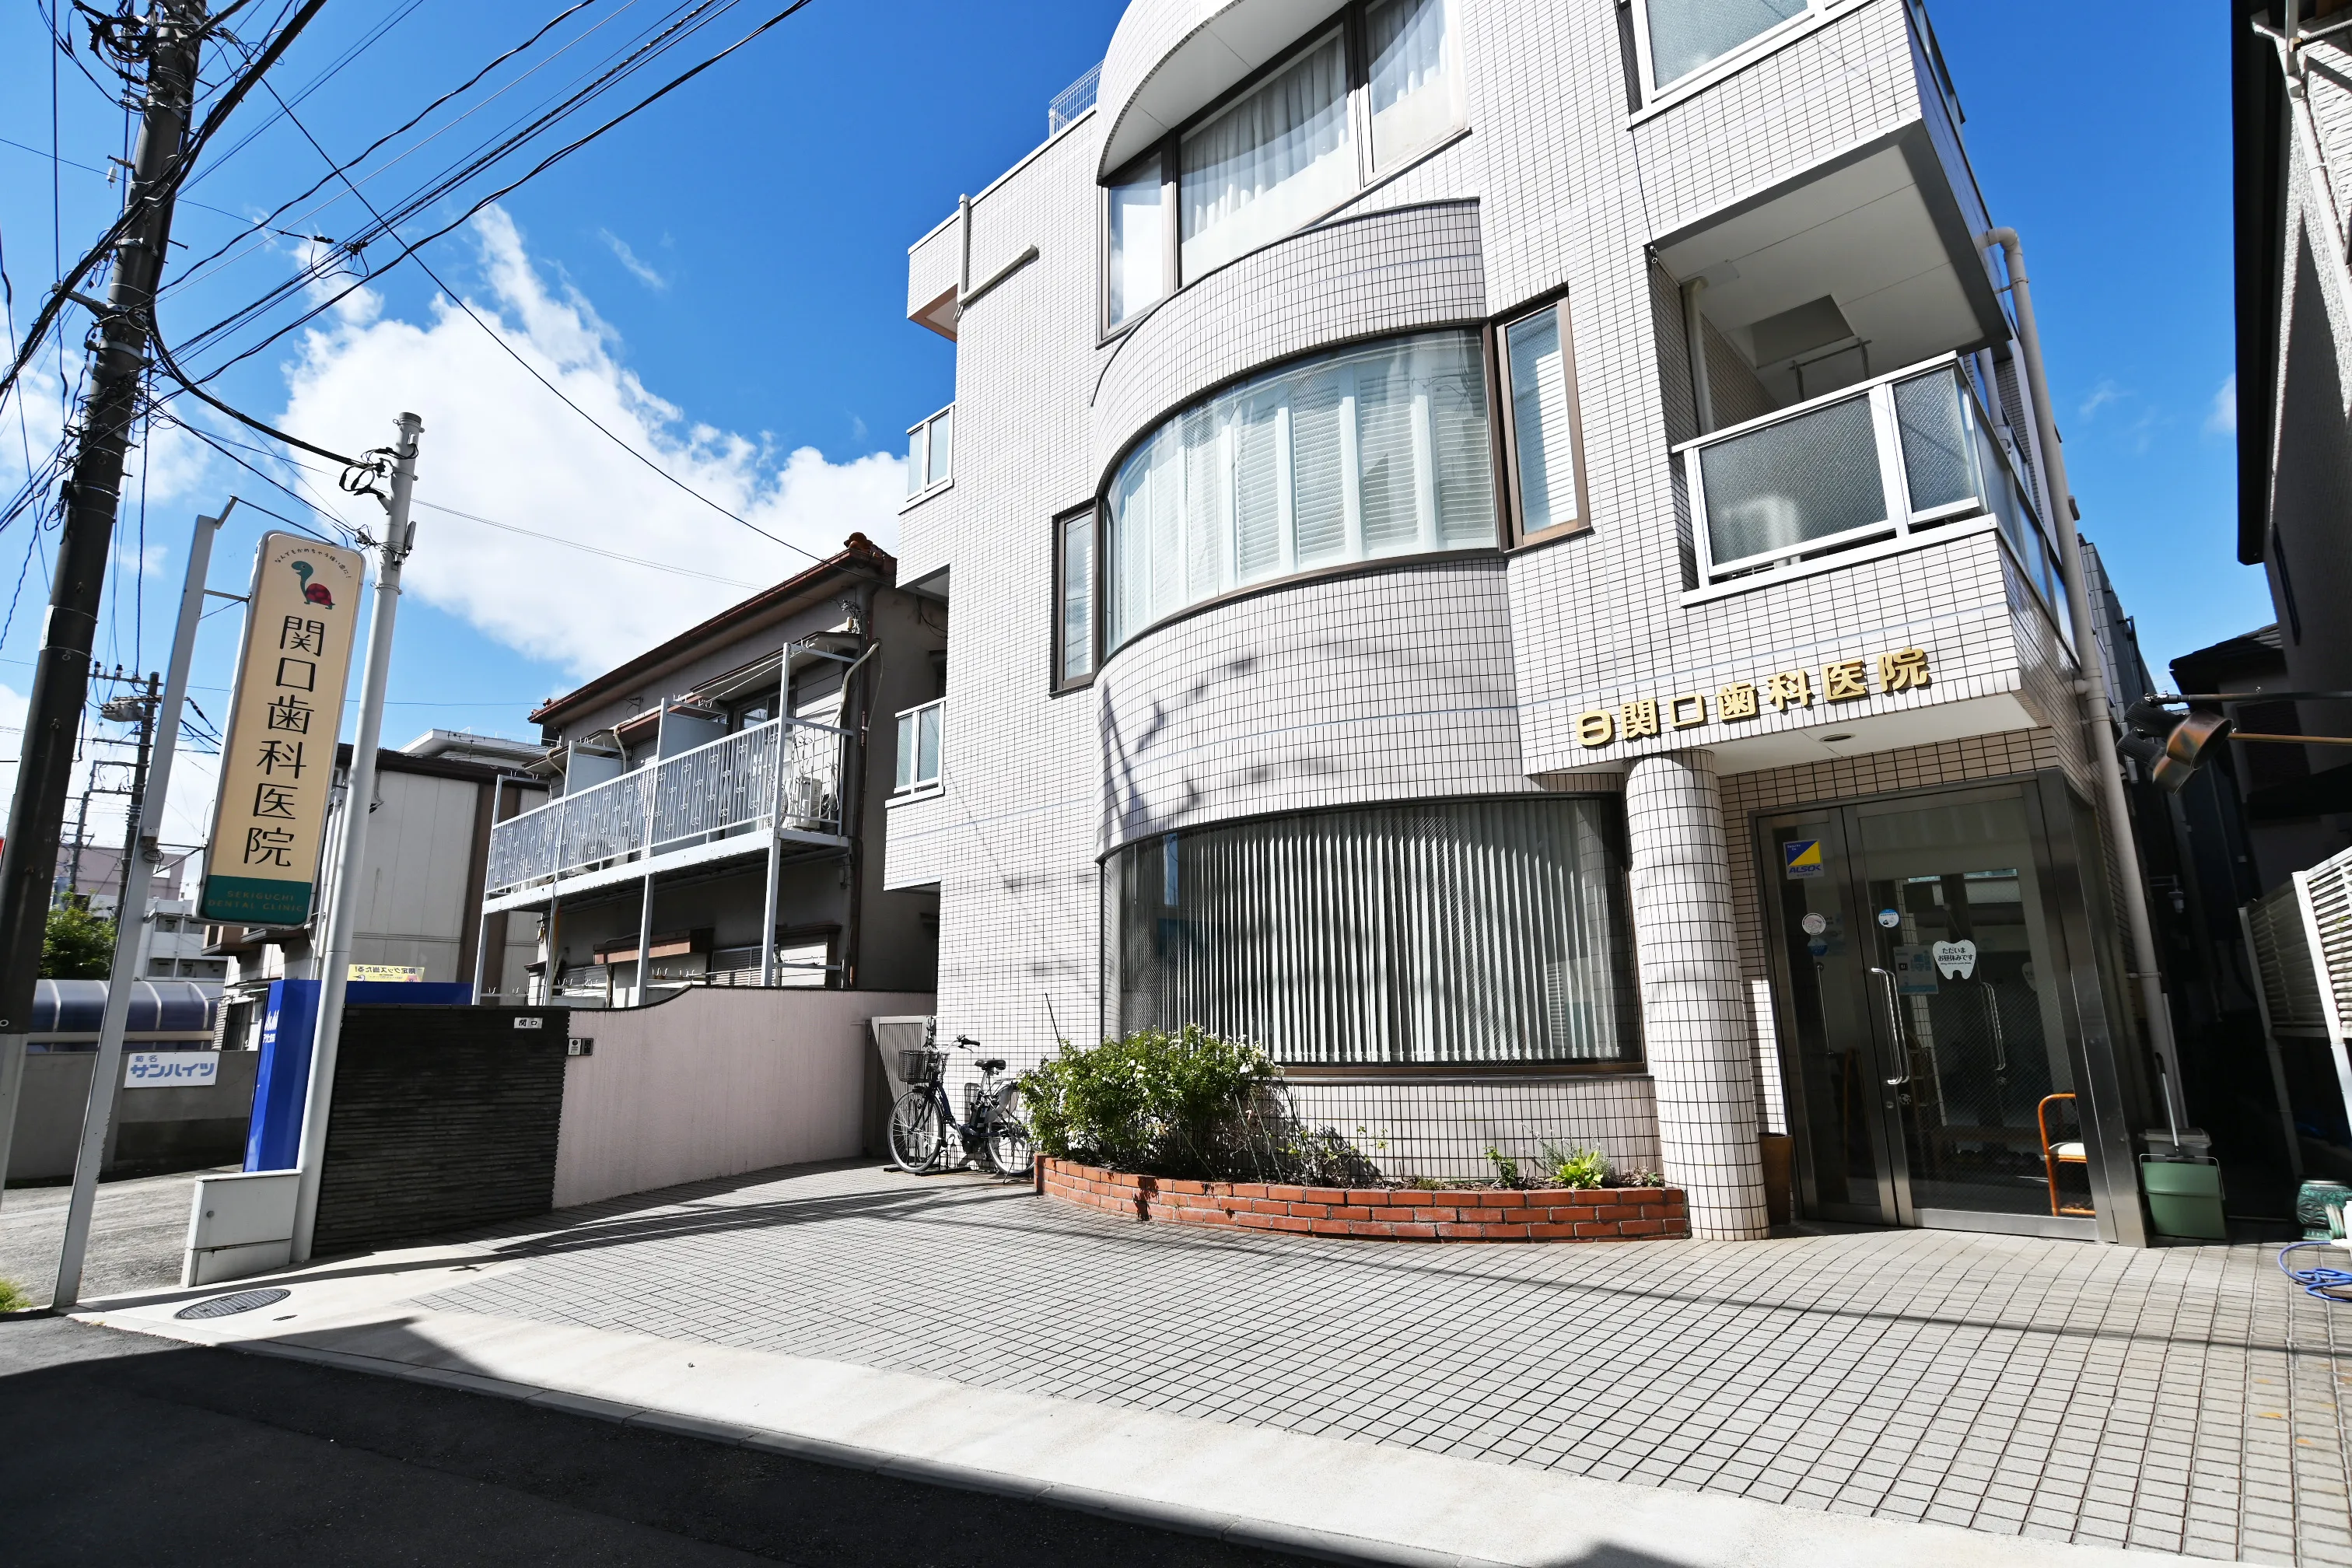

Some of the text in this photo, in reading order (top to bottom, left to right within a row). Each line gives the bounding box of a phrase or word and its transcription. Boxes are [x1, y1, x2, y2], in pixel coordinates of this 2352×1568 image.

[1620, 647, 1930, 739] 関口歯科医院
[243, 615, 325, 867] 関口歯科医院
[1789, 865, 1822, 873] ALSOK
[227, 891, 294, 901] SEKIGUCHI
[208, 899, 303, 912] DENTAL CLINIC
[130, 1062, 215, 1078] サンハイツ
